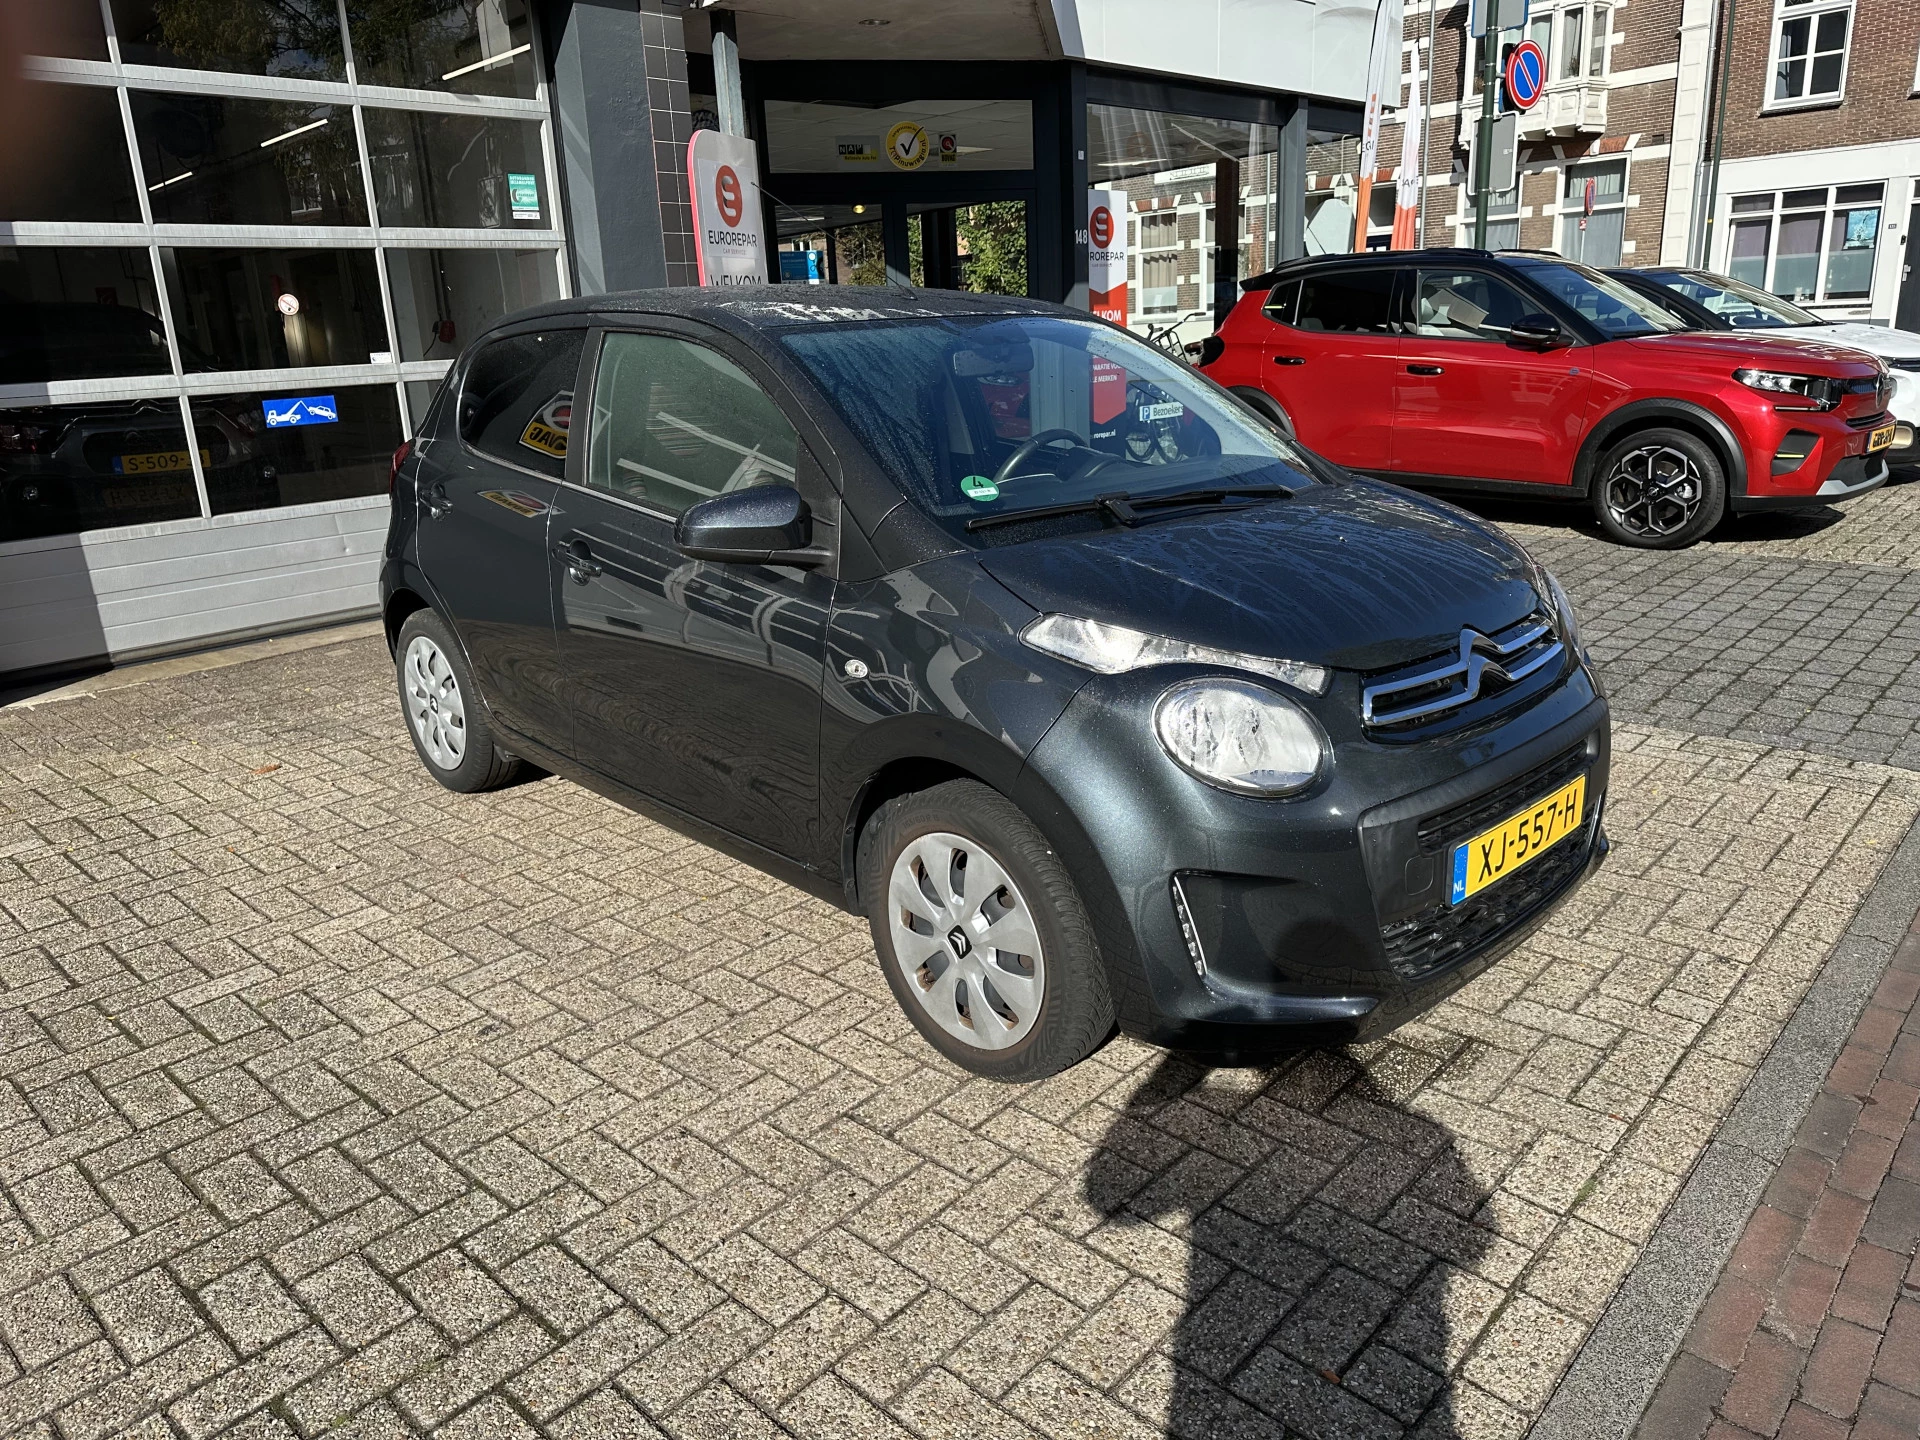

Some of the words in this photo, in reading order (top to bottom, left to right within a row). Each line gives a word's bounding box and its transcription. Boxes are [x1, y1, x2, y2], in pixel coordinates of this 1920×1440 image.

[708, 229, 758, 248] EUROREPAR
[1075, 229, 1088, 245] 148
[1089, 251, 1125, 261] ROREPAR
[972, 476, 984, 488] 4
[1478, 788, 1577, 883] XJ-557-H
[1453, 880, 1464, 894] NL
